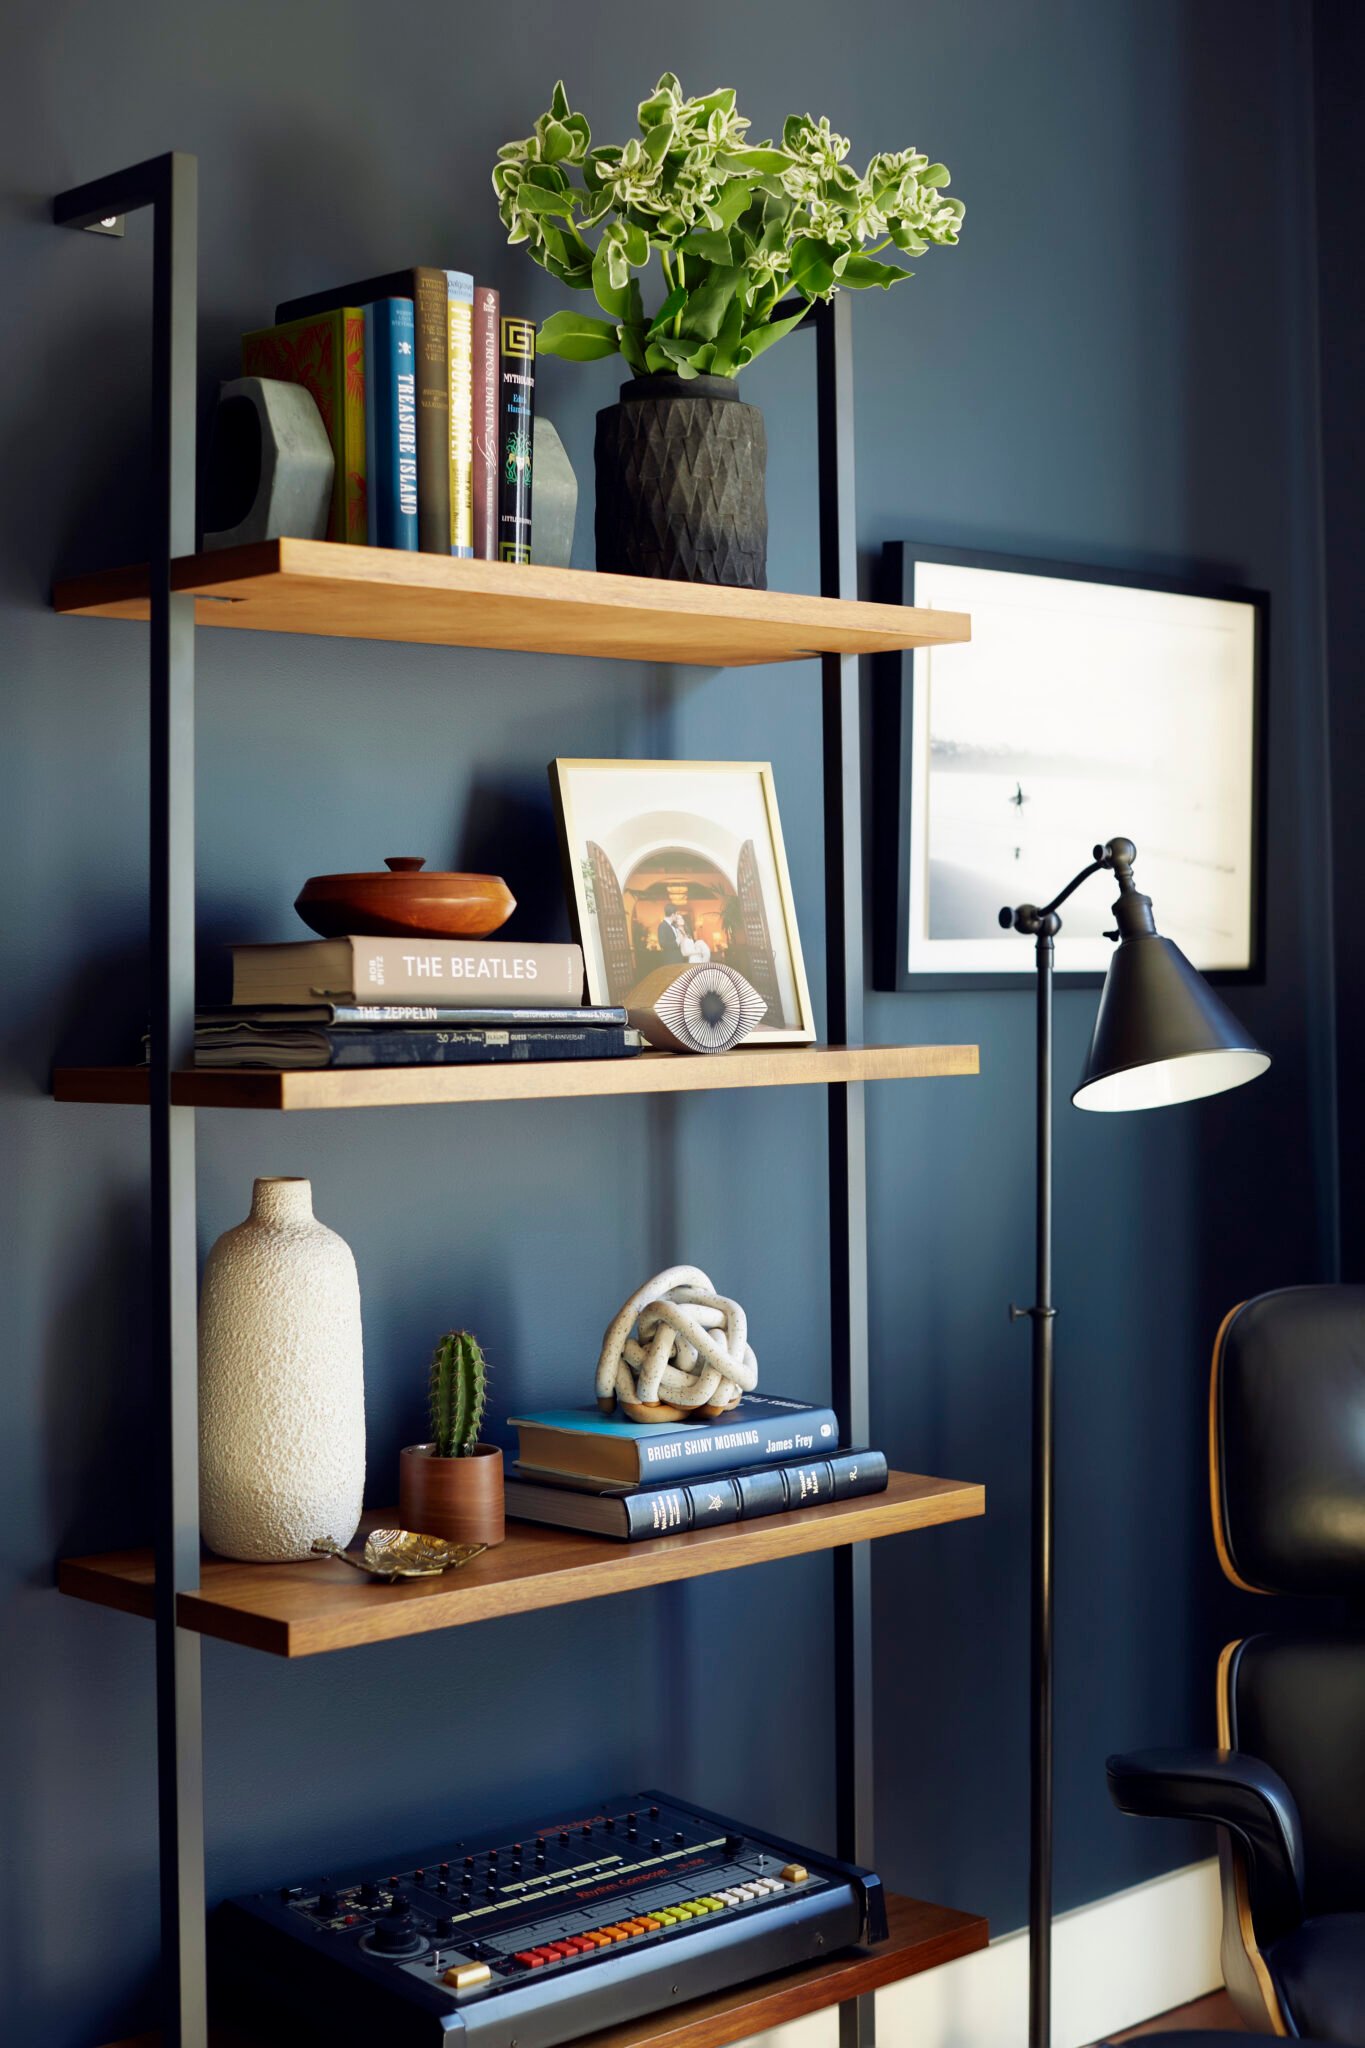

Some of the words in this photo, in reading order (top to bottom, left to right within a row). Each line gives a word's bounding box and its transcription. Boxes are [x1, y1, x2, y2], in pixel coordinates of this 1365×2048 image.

[451, 306, 472, 353] PURE
[485, 332, 495, 384] PURPOSE
[398, 374, 416, 453] TREASURE
[485, 387, 495, 433] DRIVEN
[399, 458, 417, 515] ISLAND
[402, 956, 443, 977] THE
[452, 957, 538, 980] BEATLES
[356, 1006, 380, 1020] THE
[383, 1006, 438, 1020] ZEPPELIN
[647, 1442, 682, 1462] BRIGHT
[685, 1437, 713, 1456] SHINY
[714, 1429, 759, 1449] MORNING
[766, 1438, 793, 1454] James
[795, 1434, 813, 1449] Frey
